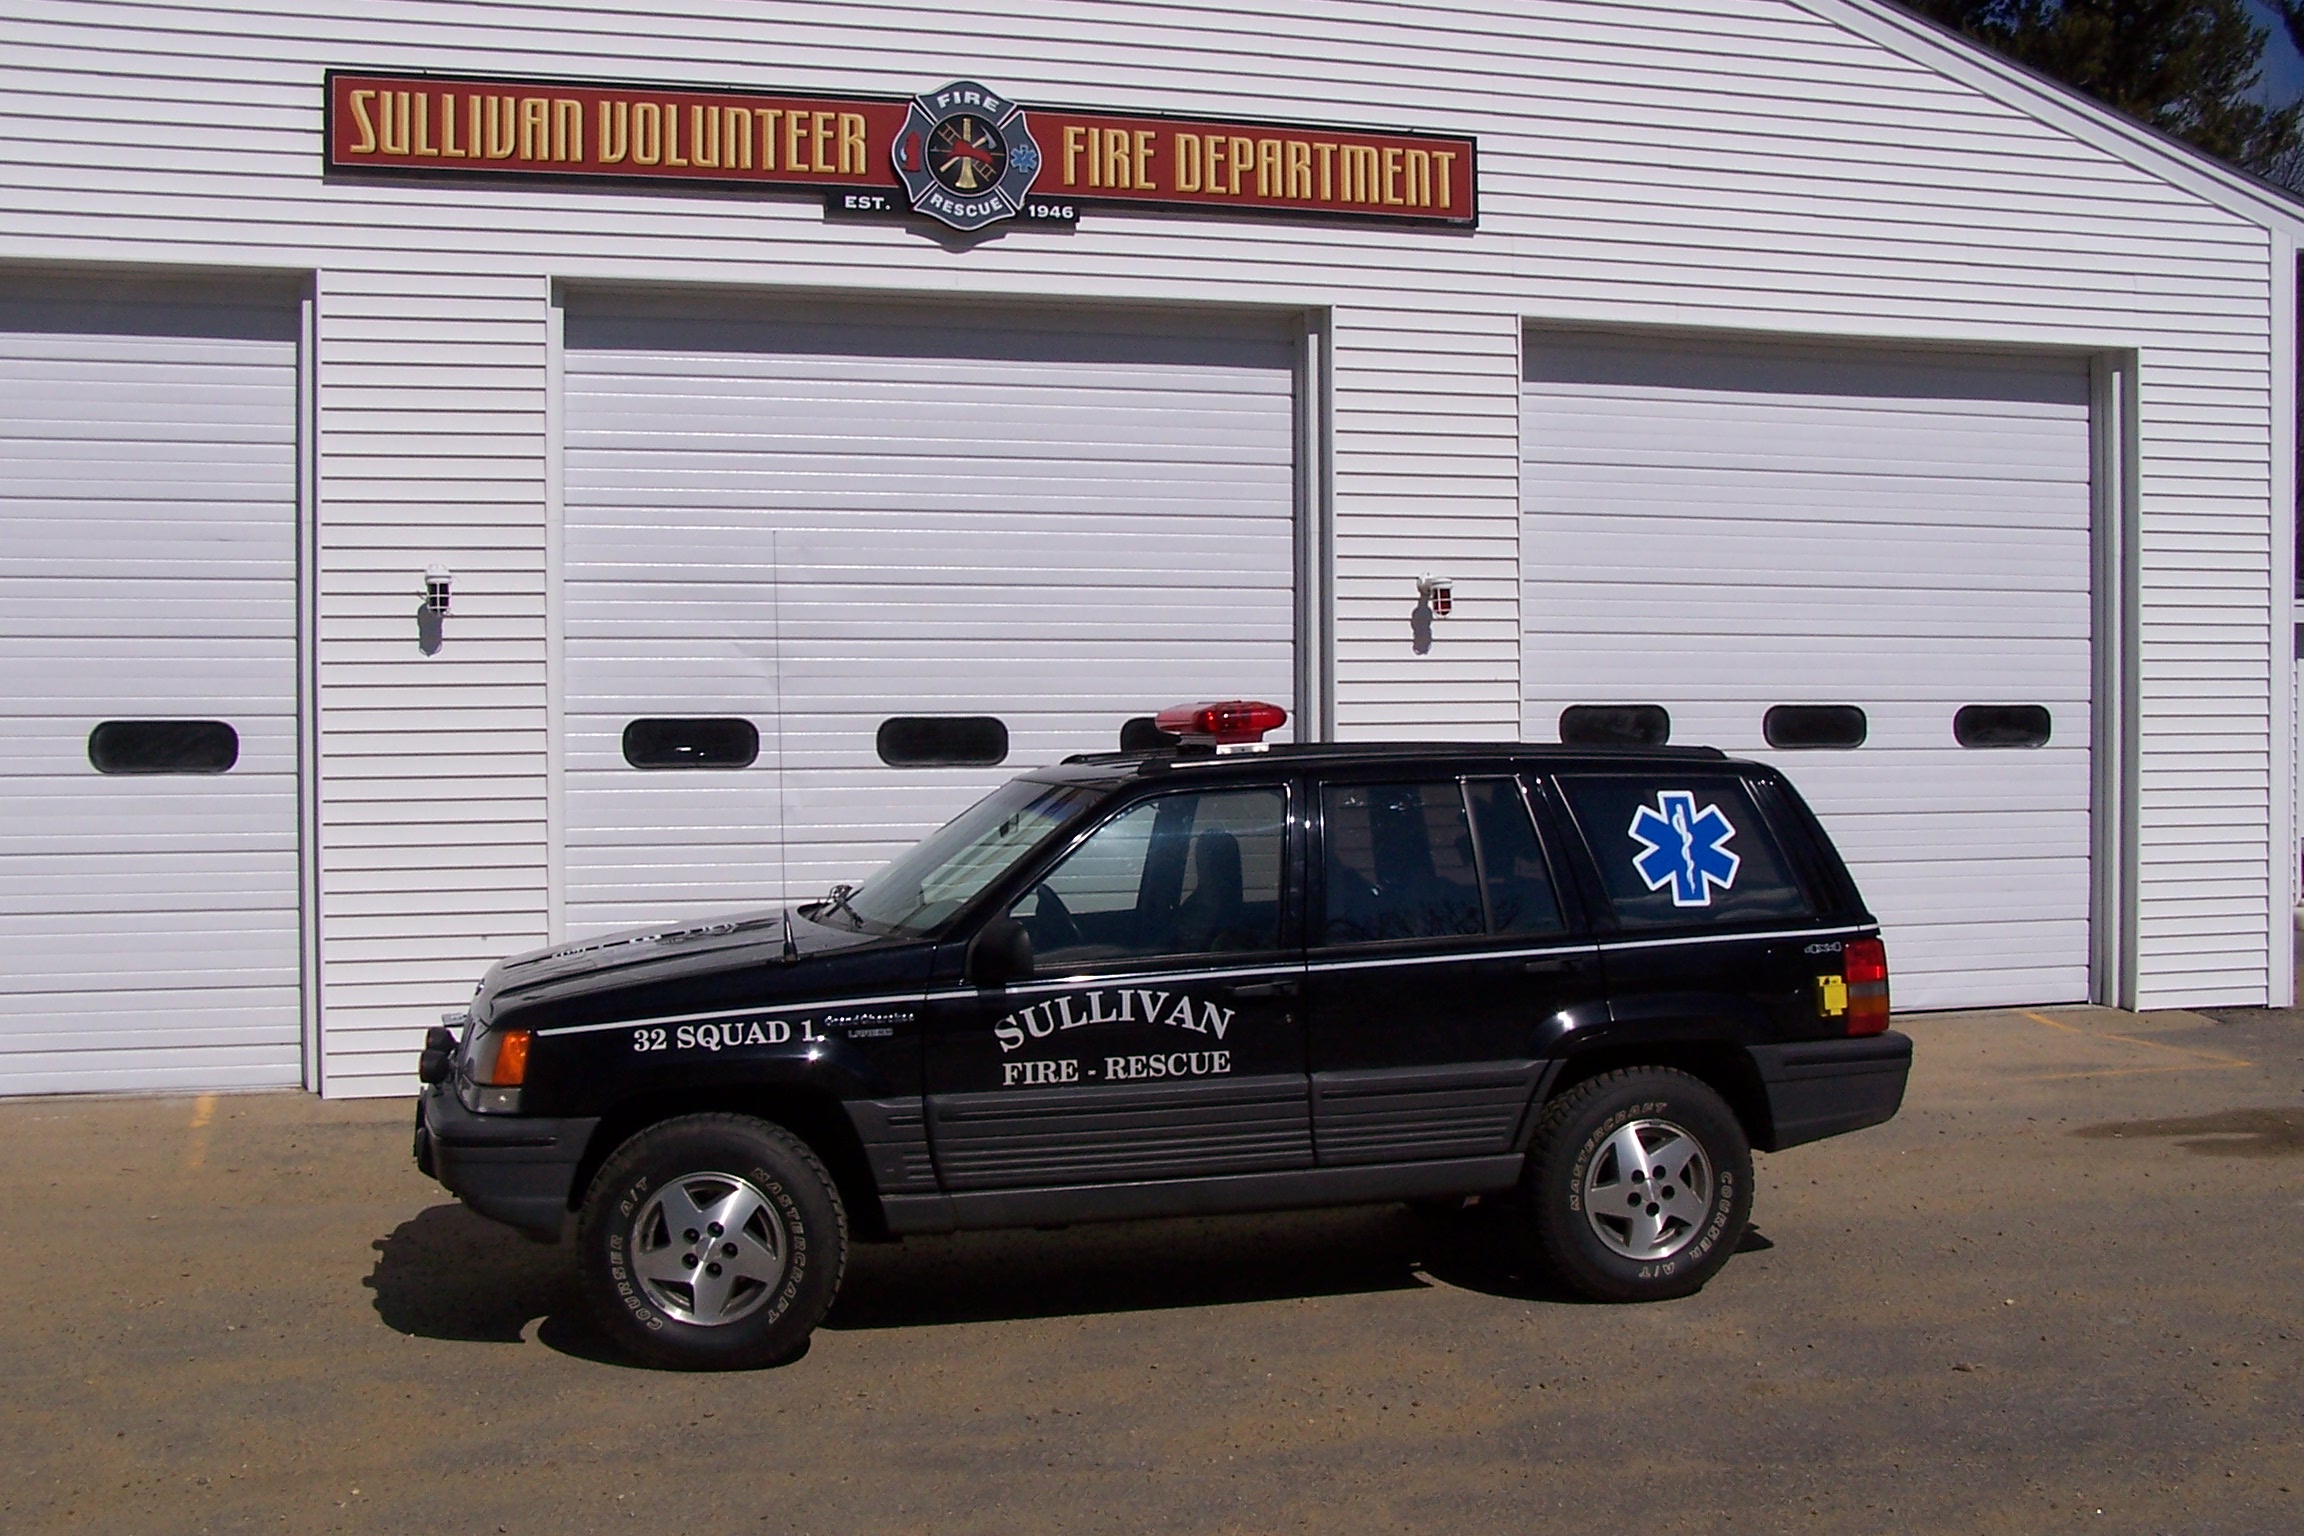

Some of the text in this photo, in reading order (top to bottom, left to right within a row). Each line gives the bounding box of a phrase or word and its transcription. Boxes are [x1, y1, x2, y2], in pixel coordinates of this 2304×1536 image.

[936, 90, 1001, 113] FIRE
[349, 89, 1457, 209] SULLIVAN VOLUNTEER FIRE DEPARTMENT
[845, 196, 1074, 219] EST. 1946
[929, 193, 1003, 218] RESCUE
[633, 1020, 815, 1052] 32 SQUAD 1
[994, 989, 1235, 1053] SULLIVAN
[1002, 1059, 1079, 1086] FIRE
[1104, 1050, 1231, 1080] RESCUE
[1689, 1171, 1733, 1260] COURSER
[609, 1176, 664, 1331] COURSER A/T
[751, 1167, 807, 1325] MASTERCRAFT
